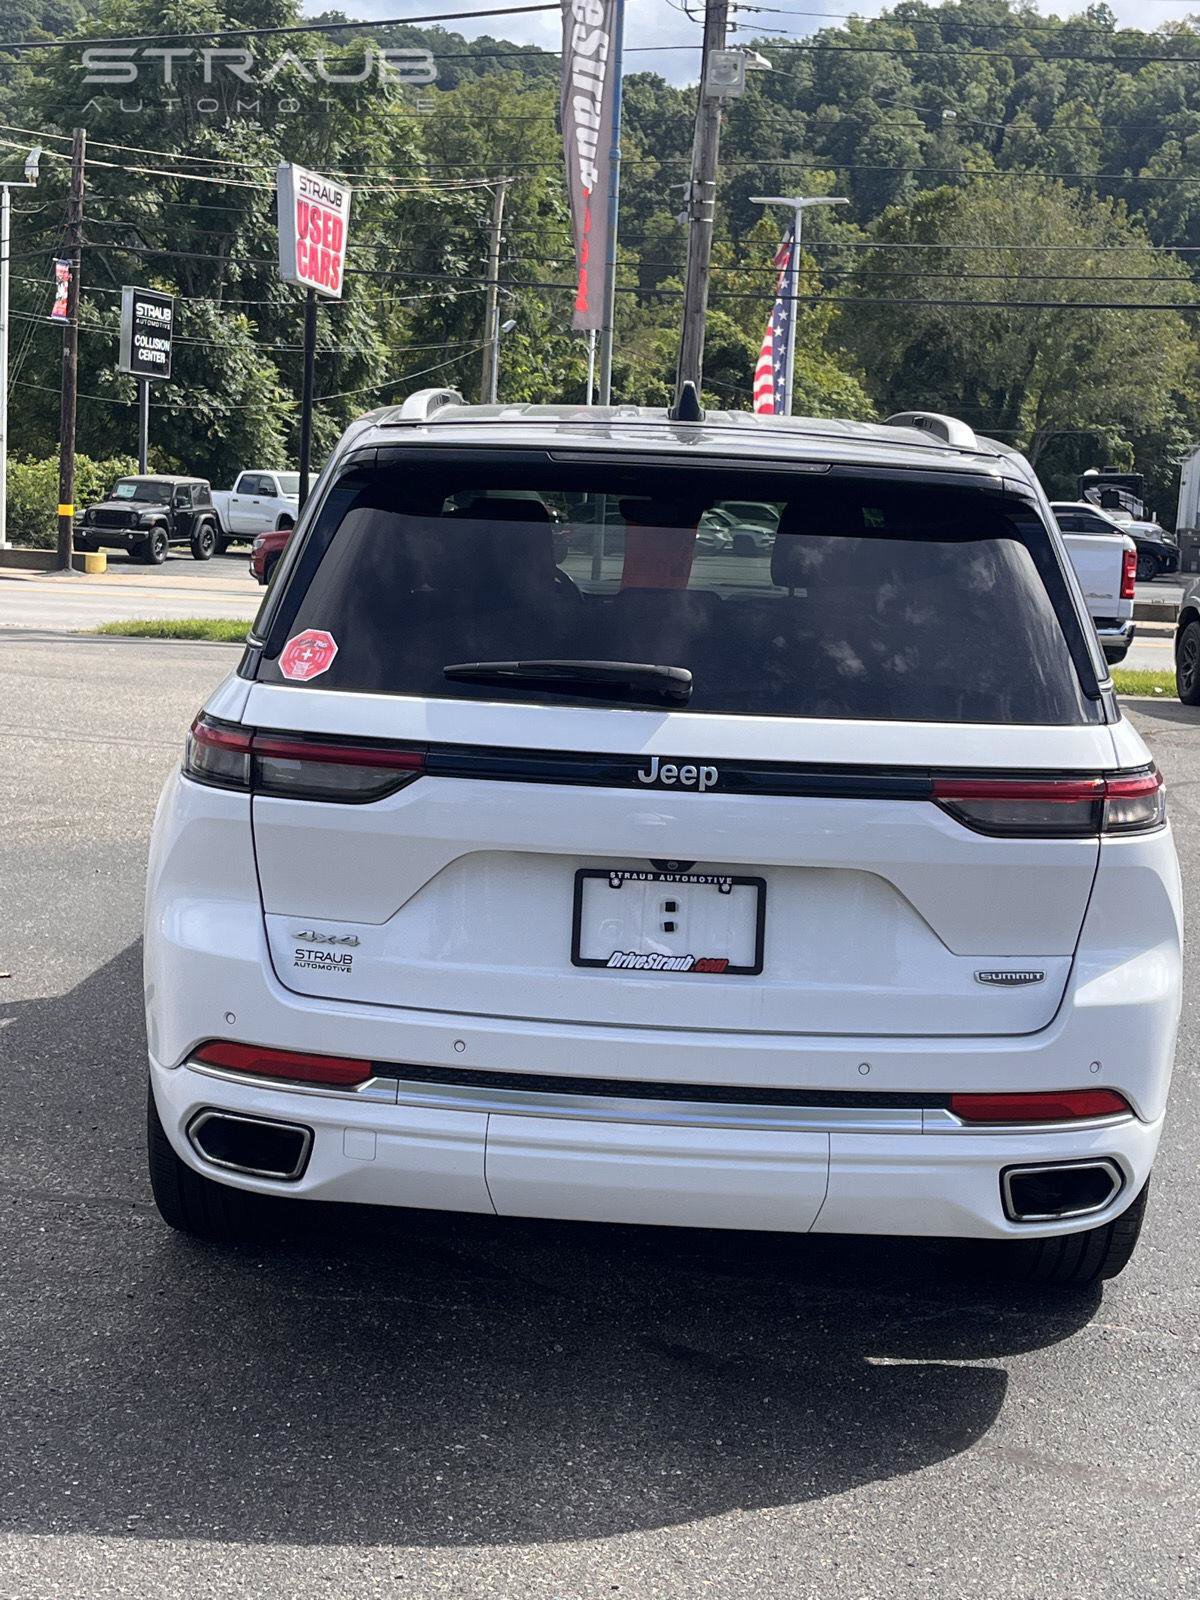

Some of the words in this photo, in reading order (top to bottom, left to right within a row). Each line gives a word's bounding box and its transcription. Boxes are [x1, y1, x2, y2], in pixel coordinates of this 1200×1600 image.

[299, 175, 343, 208] STRAUB
[296, 199, 343, 254] USED
[296, 238, 341, 291] CARS
[135, 303, 171, 320] STRAUB
[135, 318, 171, 330] AUTOMOTIVE
[134, 335, 170, 351] COLLISION
[138, 349, 165, 363] CENTER
[637, 756, 719, 792] Jeep
[609, 871, 654, 881] STRAUB
[659, 873, 733, 884] AUTOMOTIVE
[291, 930, 361, 947] 4x4
[294, 948, 353, 964] STRAUB
[606, 951, 730, 973] DriveStraub.com
[293, 961, 352, 973] AUTOMOTIVE
[980, 973, 1043, 981] SUMMIT
